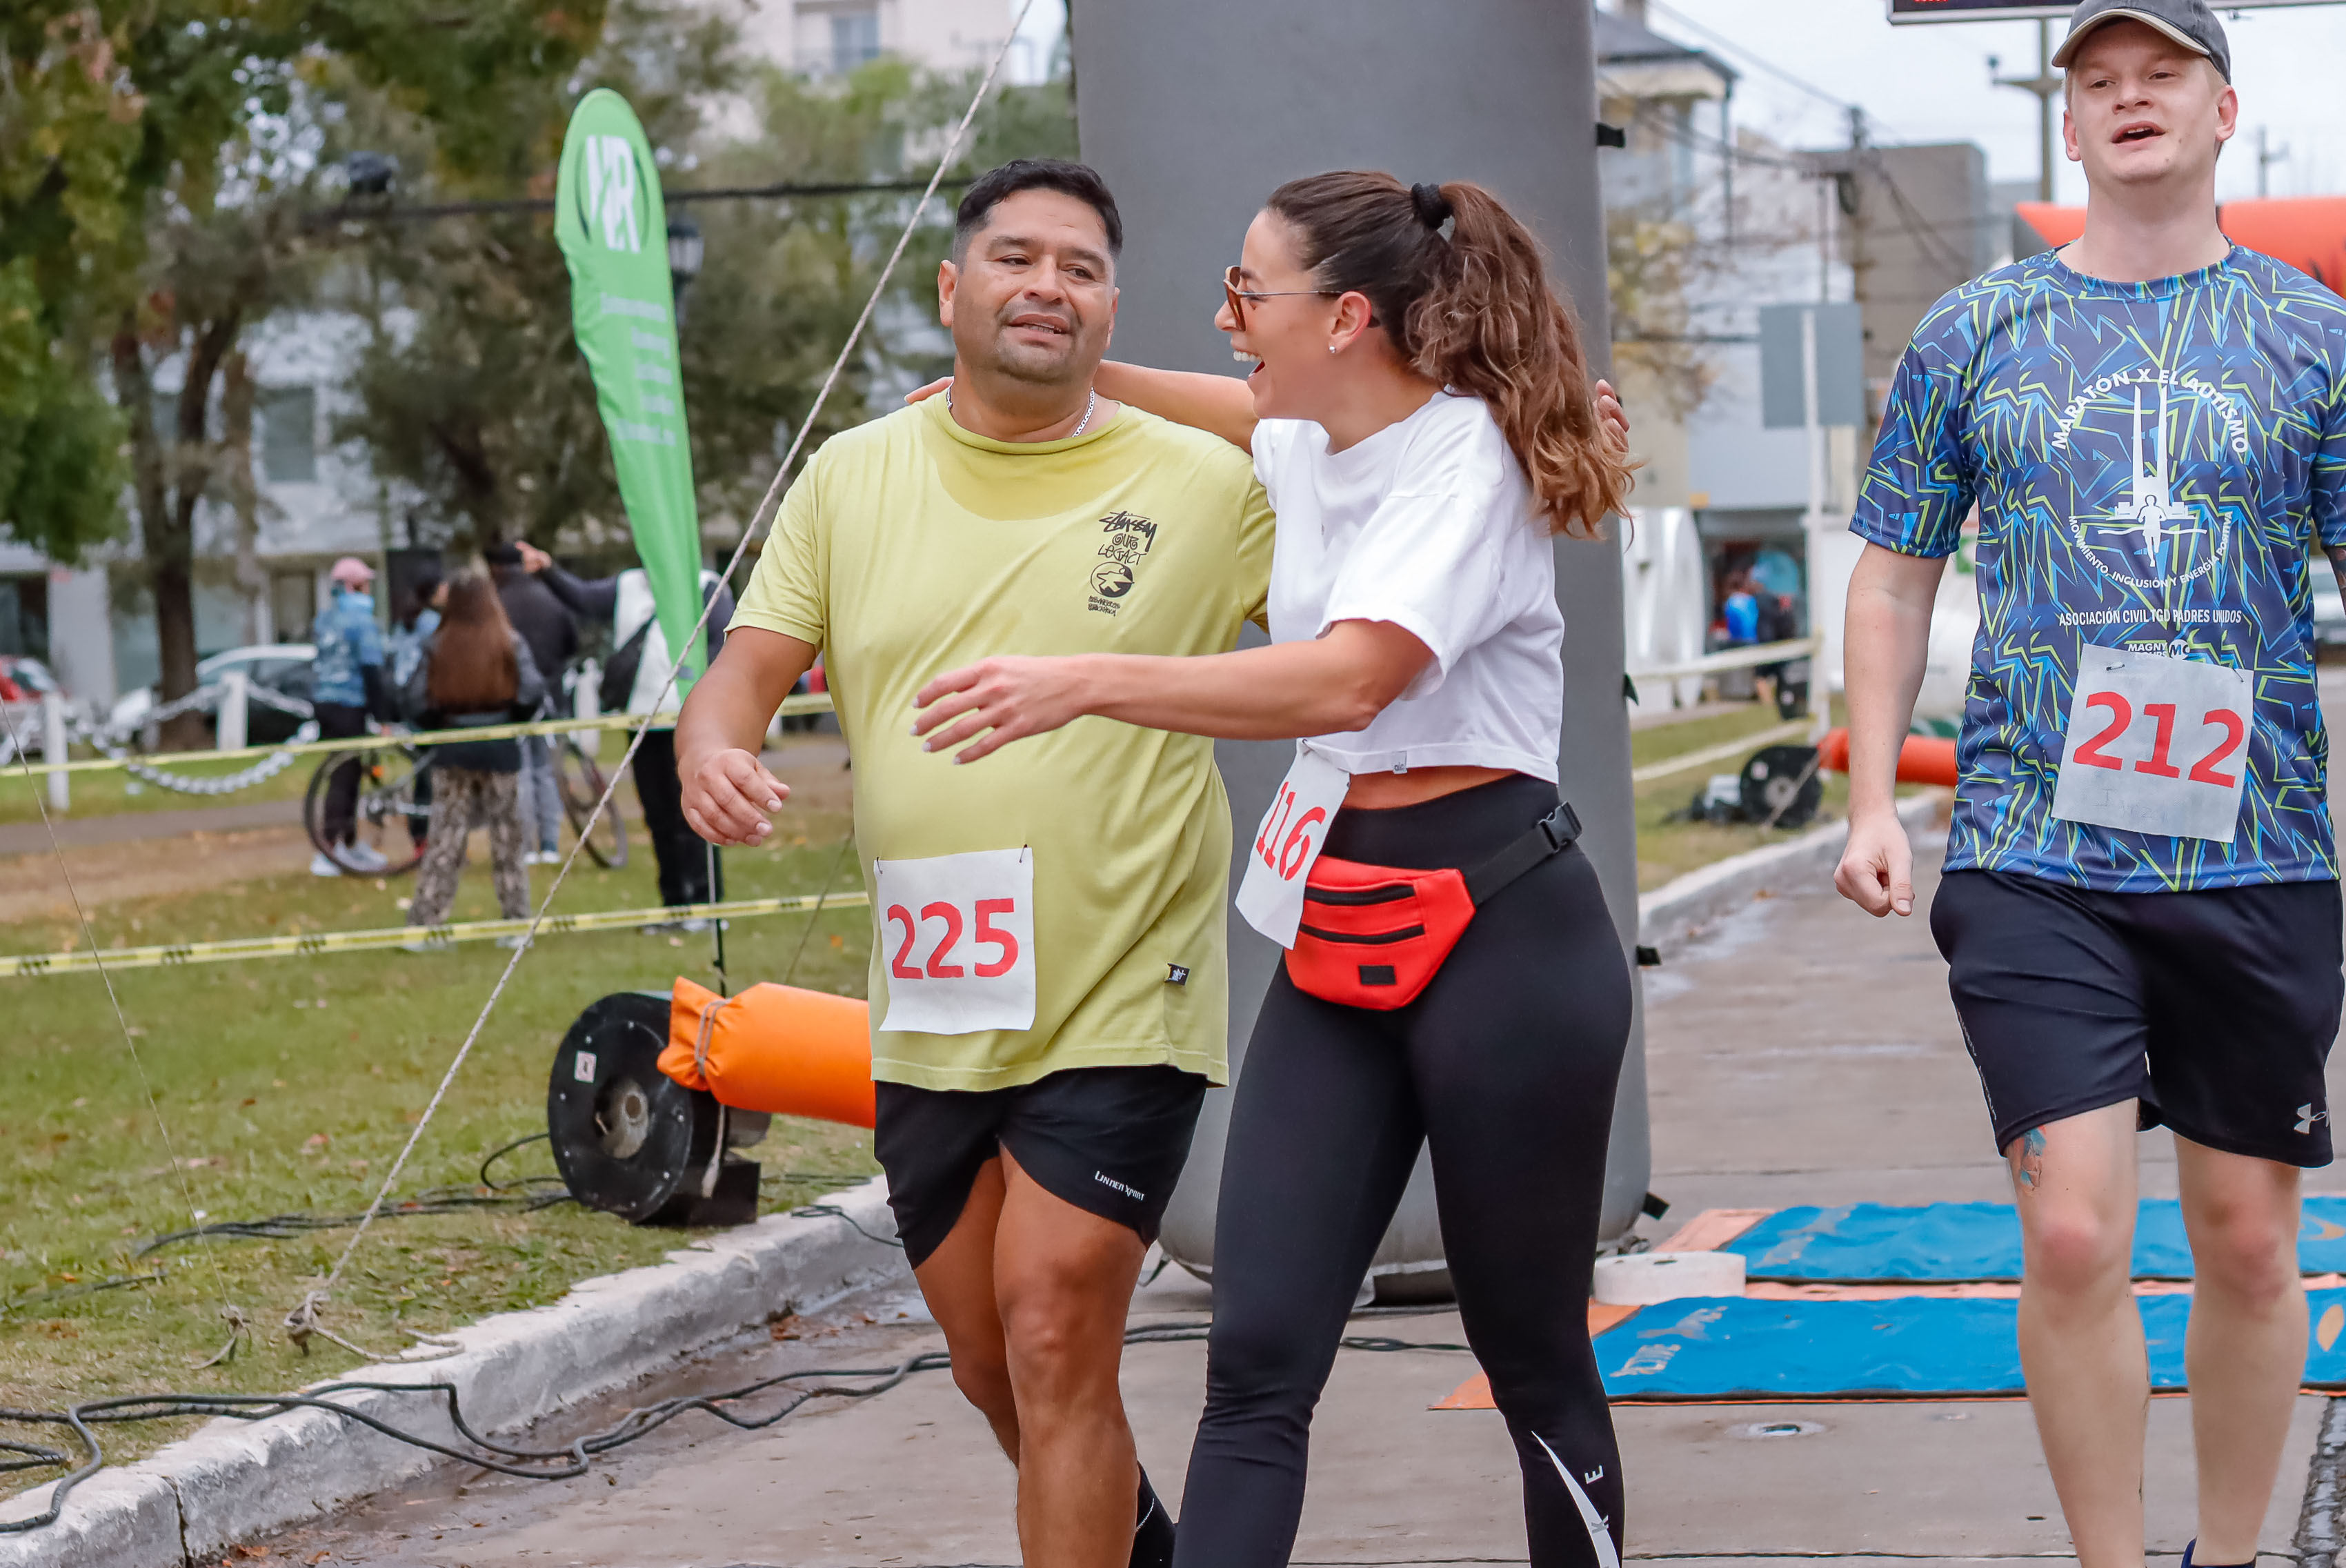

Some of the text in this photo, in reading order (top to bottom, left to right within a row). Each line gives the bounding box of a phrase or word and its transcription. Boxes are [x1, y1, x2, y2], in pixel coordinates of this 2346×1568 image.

[2051, 368, 2248, 453] MARATÓN X EL AUTISMO
[2069, 511, 2233, 588] MOVIMIENTO, INCLUSIÓN Y ENERGÍA POSITIVA
[2059, 606, 2242, 626] ASOCIACIÓN CIVIL TGD PADRES UNIDOS
[2128, 643, 2167, 652] MAGNY
[2073, 691, 2244, 788] 212
[1256, 782, 1326, 881] 116
[888, 898, 1019, 980] 225
